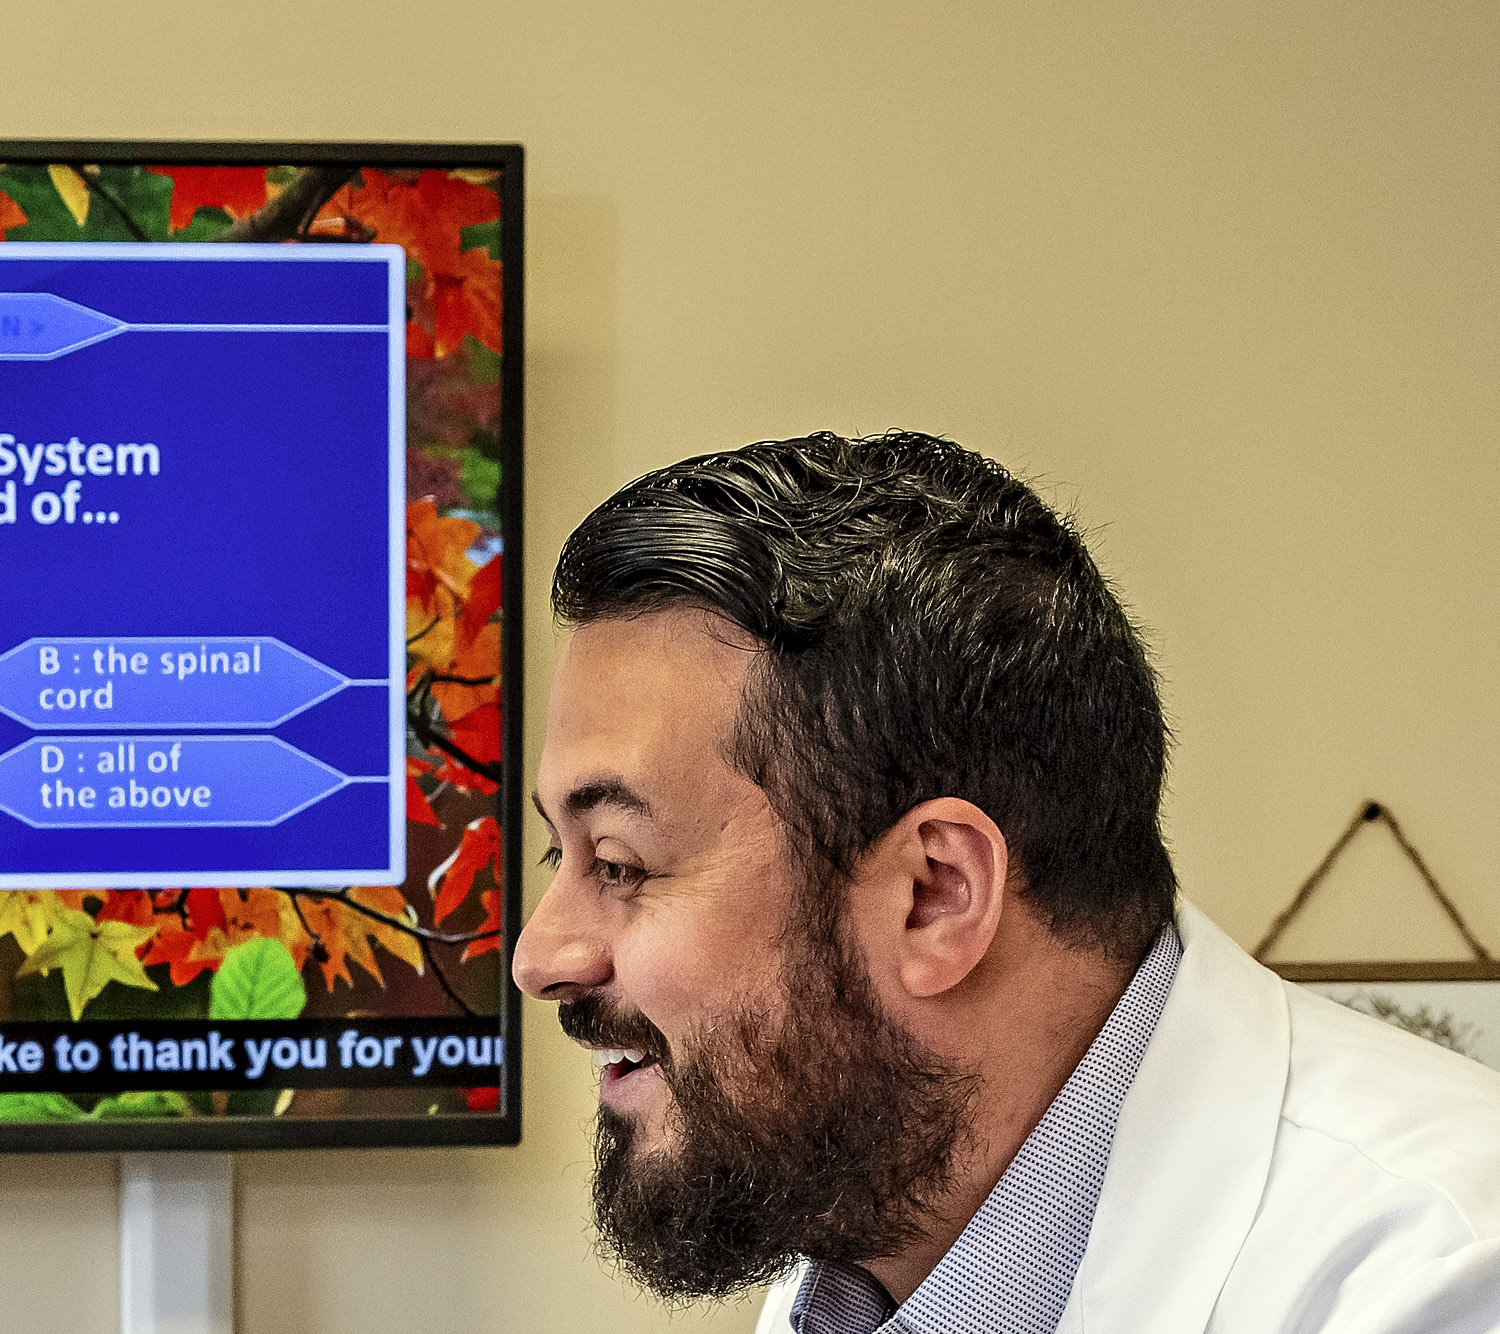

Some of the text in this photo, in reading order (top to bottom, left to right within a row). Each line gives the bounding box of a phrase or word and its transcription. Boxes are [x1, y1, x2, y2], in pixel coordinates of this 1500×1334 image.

[31, 480, 120, 524] of...
[39, 646, 60, 675] B
[93, 644, 149, 675] the
[161, 644, 261, 680] spinal
[39, 681, 113, 710] cord
[41, 745, 64, 774] D
[97, 742, 135, 774] all
[148, 742, 182, 773] of
[40, 779, 211, 809] the above
[54, 1038, 99, 1072] to
[111, 1031, 232, 1071] thank
[245, 1038, 326, 1080] you
[338, 1031, 404, 1068] for
